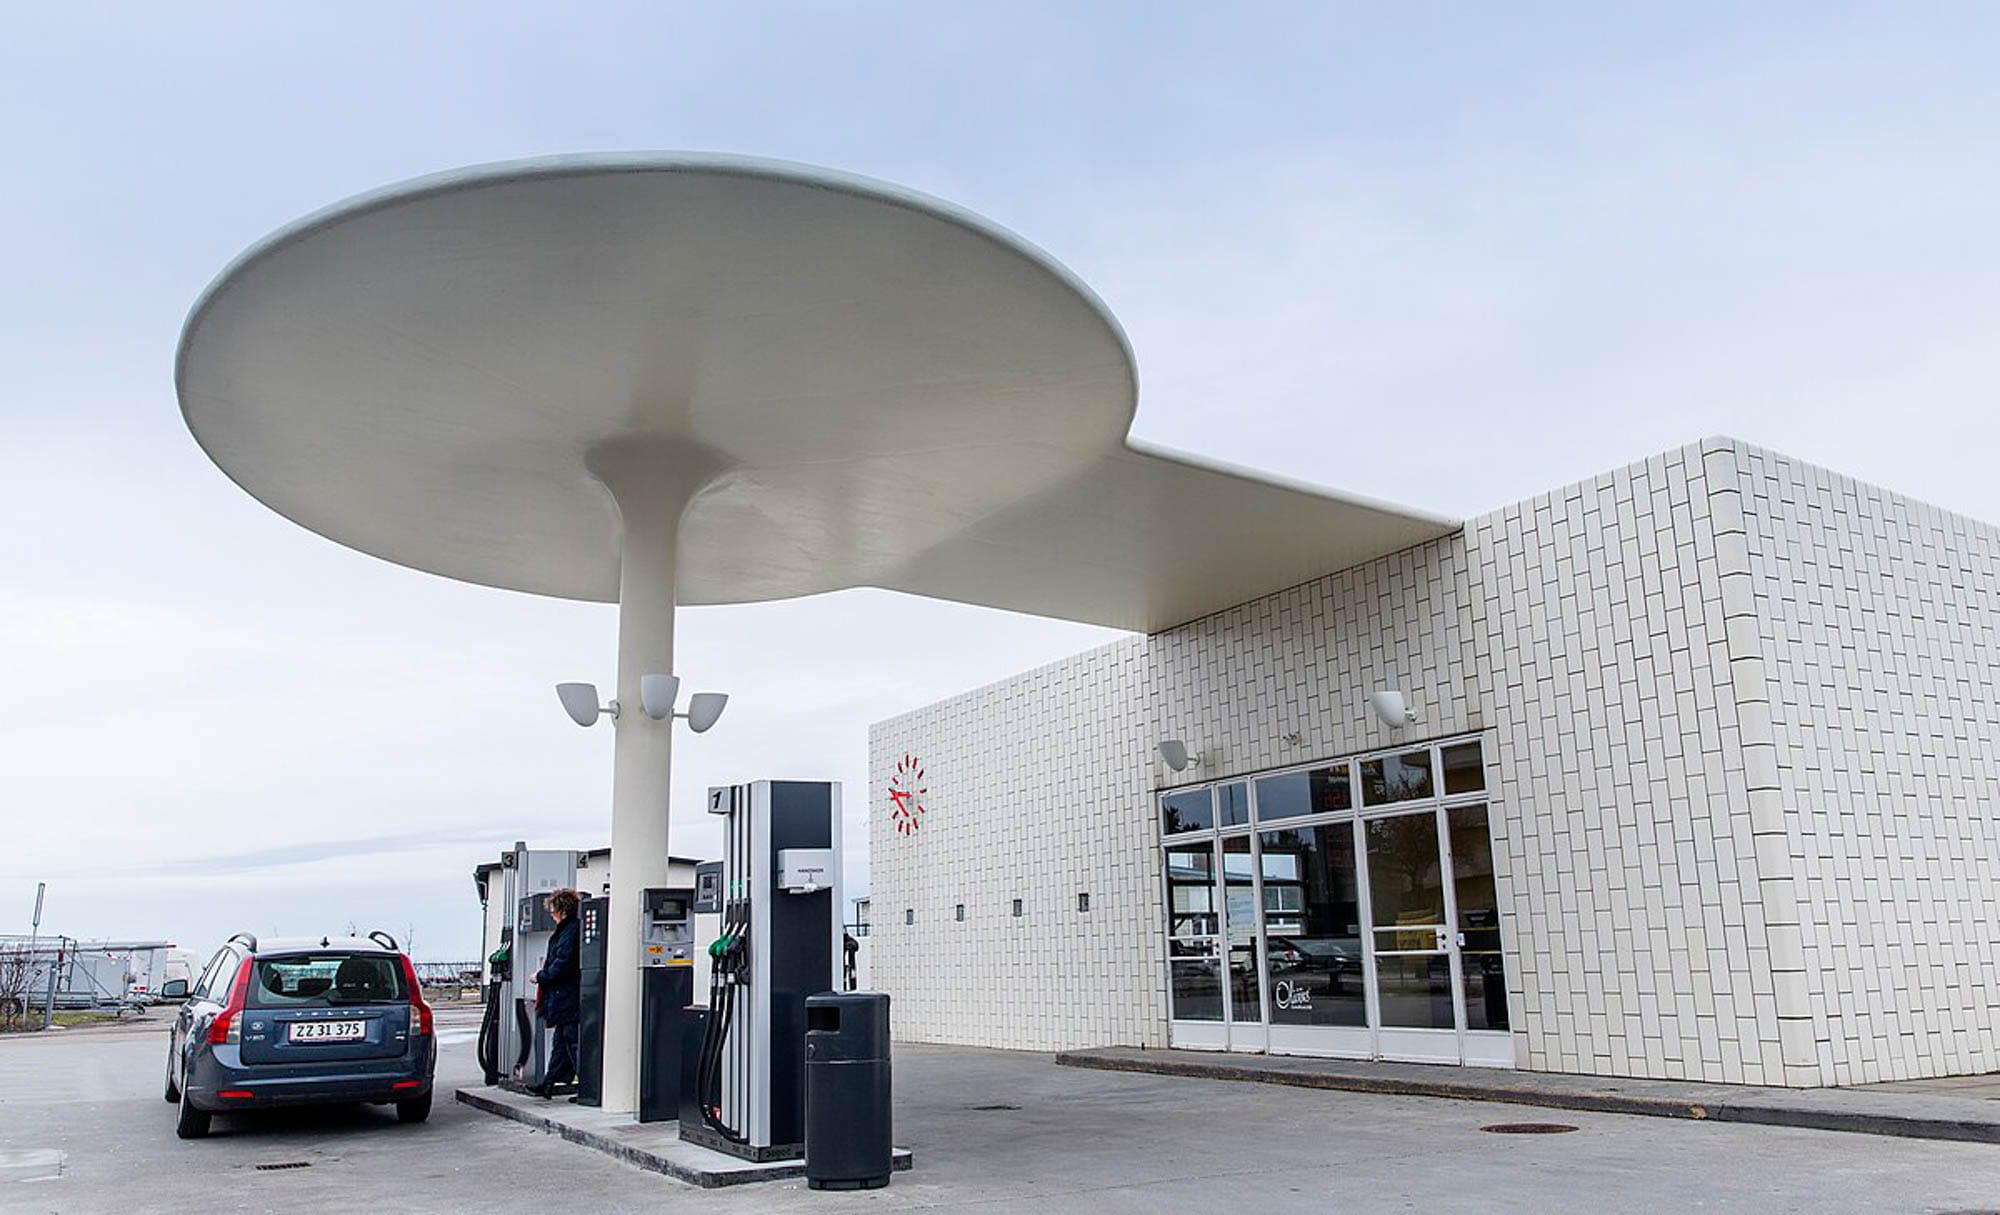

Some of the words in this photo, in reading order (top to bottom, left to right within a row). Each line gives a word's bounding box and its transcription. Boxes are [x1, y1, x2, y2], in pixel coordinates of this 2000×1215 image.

[712, 791, 722, 810] 1
[504, 854, 514, 868] 3
[579, 854, 587, 867] 4
[296, 1025, 314, 1037] ZZ
[317, 1024, 331, 1036] 31
[336, 1023, 359, 1036] 375
